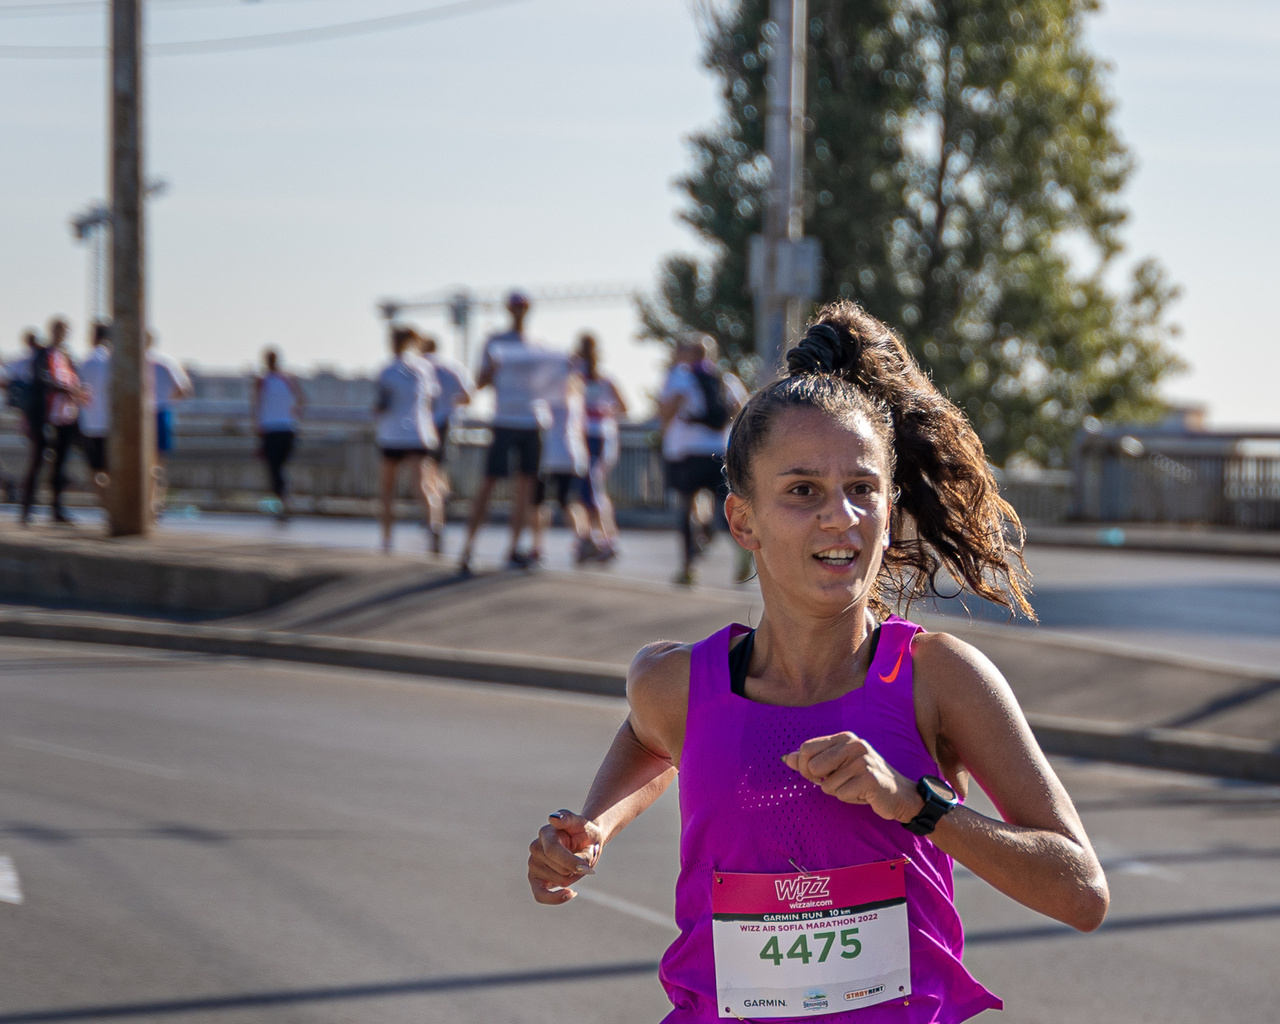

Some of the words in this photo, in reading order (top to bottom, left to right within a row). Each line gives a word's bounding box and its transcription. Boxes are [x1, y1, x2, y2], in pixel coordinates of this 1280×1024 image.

[789, 900, 833, 910] wizzair.com
[763, 913, 800, 922] GARMIN
[801, 911, 823, 921] RUN
[829, 909, 839, 917] 10
[778, 923, 804, 932] SOFIA
[806, 917, 856, 931] MARATHON
[857, 913, 878, 923] 2022
[759, 927, 862, 966] 4475
